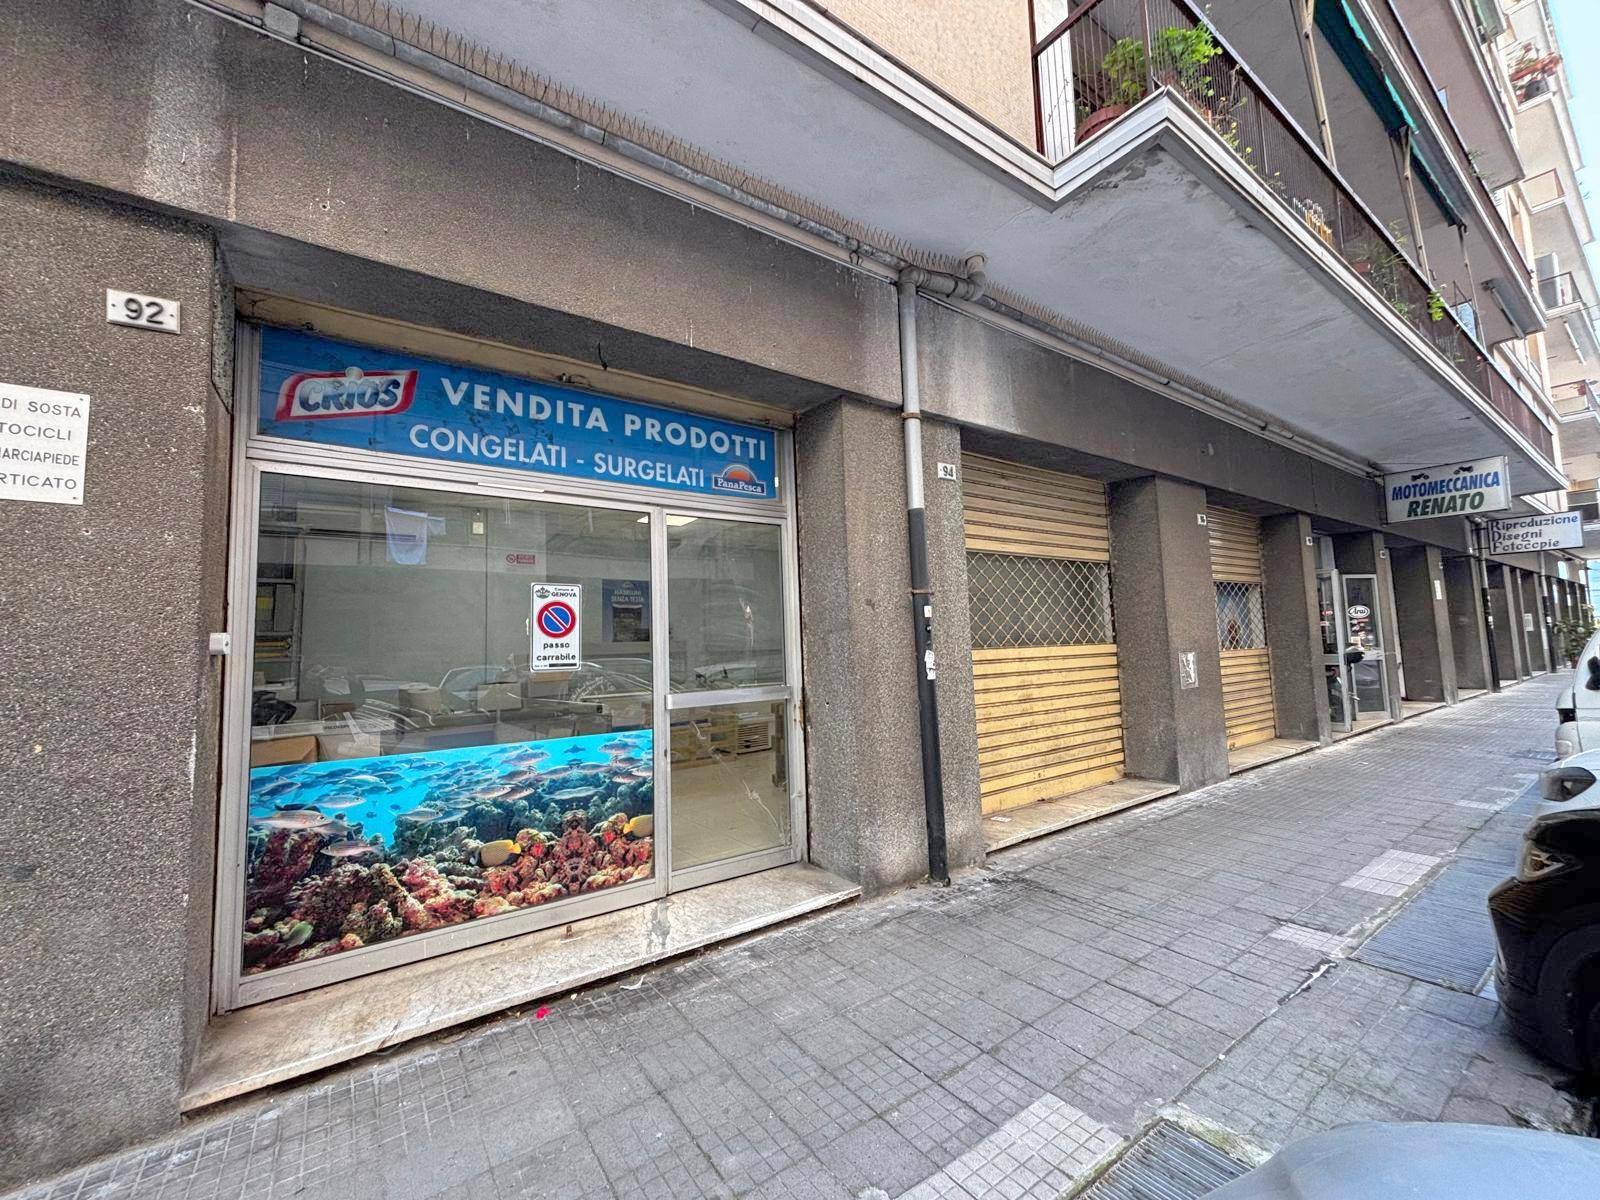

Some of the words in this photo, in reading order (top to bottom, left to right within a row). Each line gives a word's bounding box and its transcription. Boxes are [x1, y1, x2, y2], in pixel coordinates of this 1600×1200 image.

[124, 297, 164, 325] 92
[1, 397, 18, 410] DI
[27, 401, 82, 418] SOSTA
[440, 377, 609, 432] VENDITA
[624, 413, 766, 461] PRODOTTI
[0, 447, 80, 466] ARCIAPIEDE
[409, 424, 567, 469] CONGELATI
[593, 452, 705, 488] SURGELATI
[942, 465, 954, 478] 94
[716, 477, 762, 493] PanaPesca
[1391, 471, 1501, 501] MOTOMECCANICA
[1406, 491, 1486, 518] RENATO
[1490, 515, 1579, 531] Riproduzione
[1491, 529, 1543, 543] Disegni
[1492, 538, 1560, 553] Fotocopie
[543, 642, 570, 650] passo
[536, 653, 576, 661] carrabile
